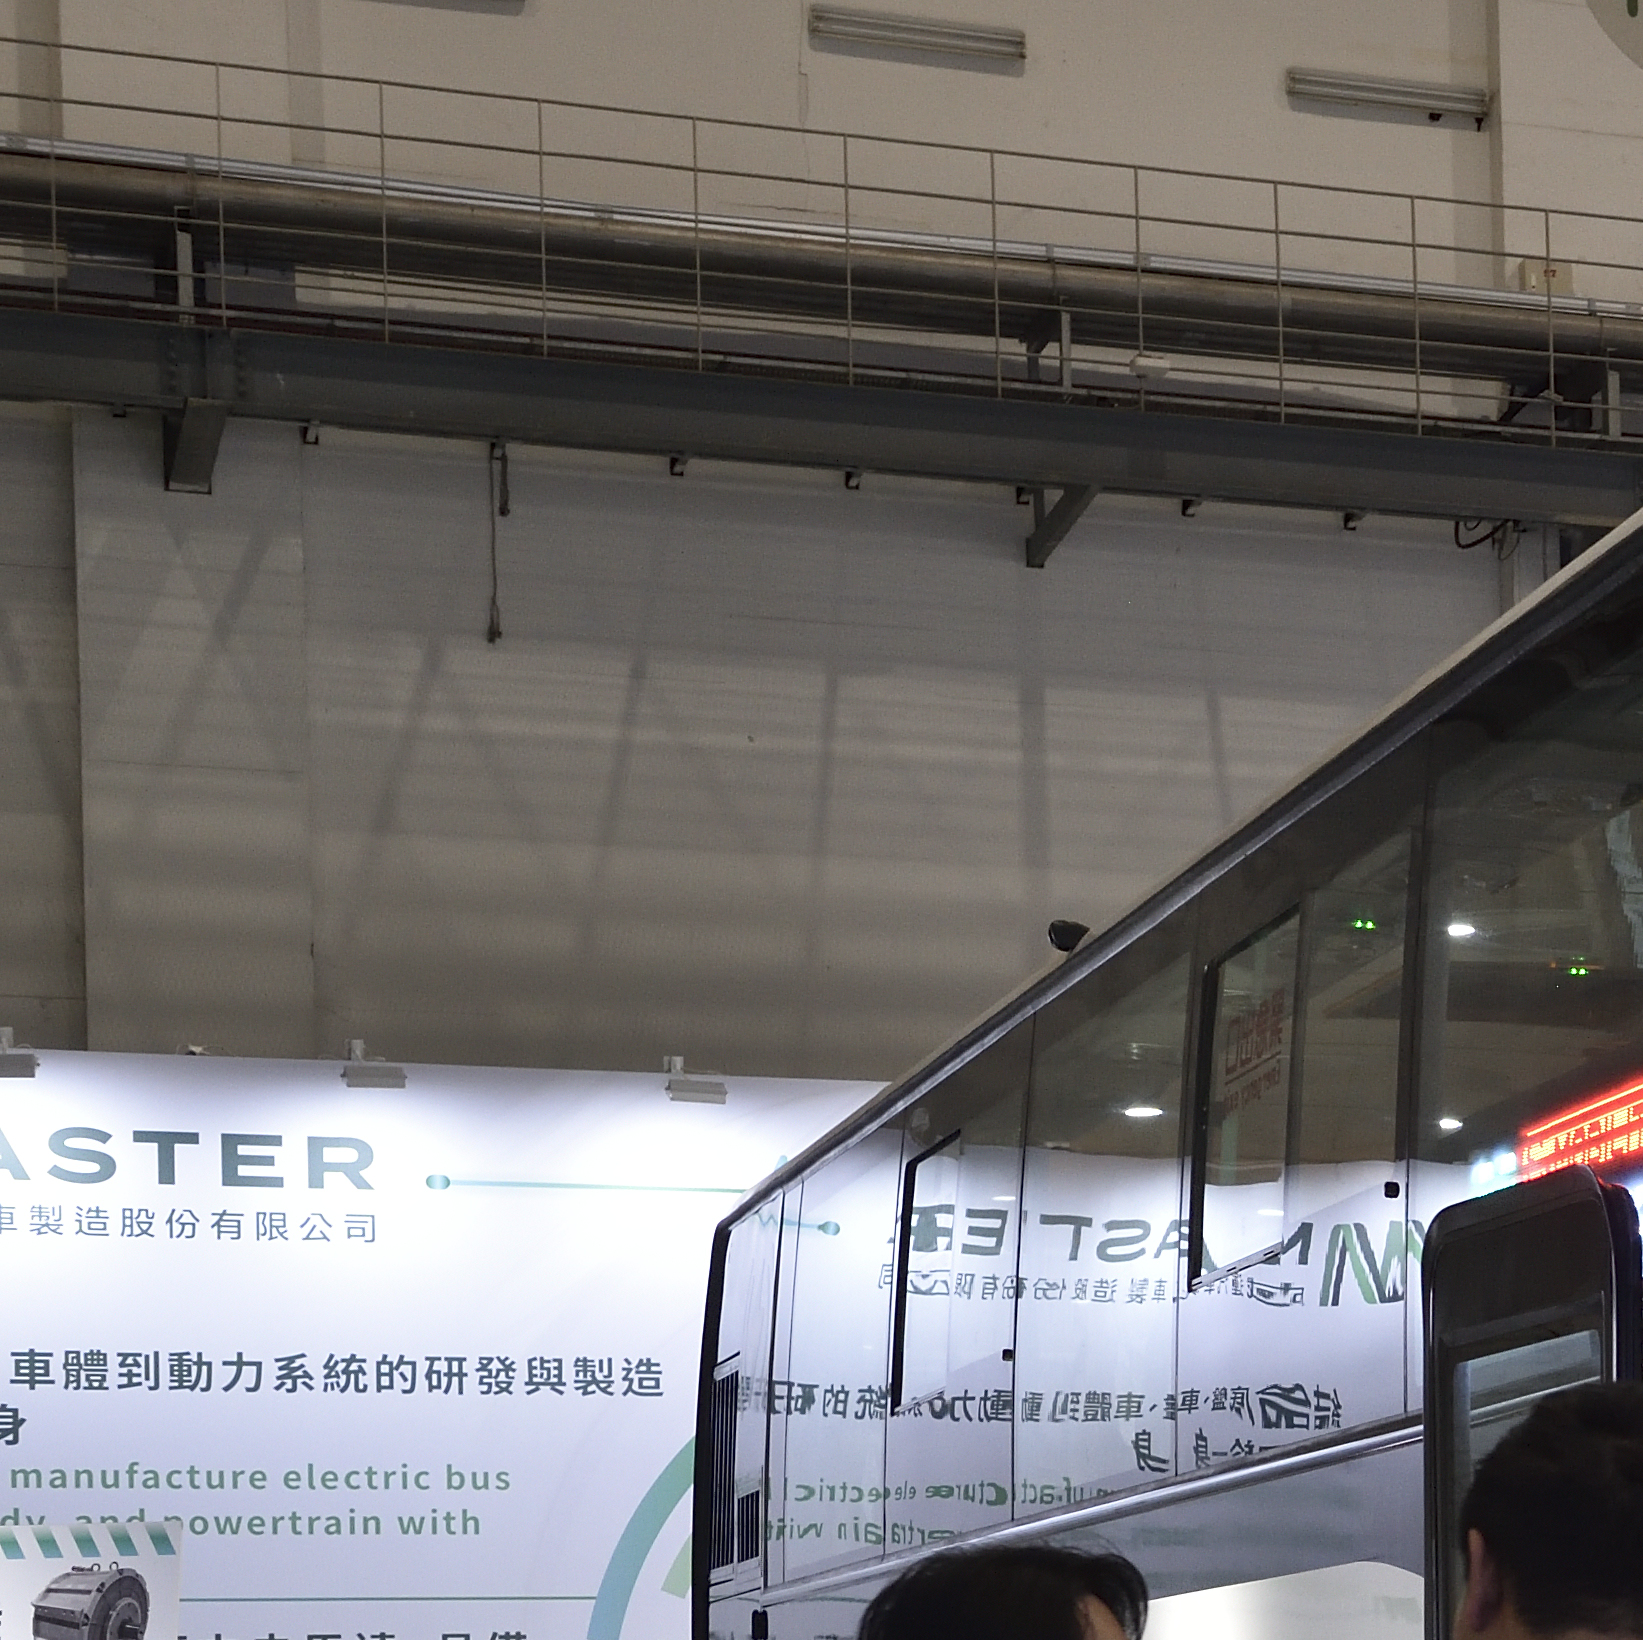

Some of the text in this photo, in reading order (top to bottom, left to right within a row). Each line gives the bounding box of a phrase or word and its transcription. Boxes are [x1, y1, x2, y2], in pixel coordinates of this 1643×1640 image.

[9, 1349, 664, 1398] 車體到動力系統的研發與製造
[9, 1461, 512, 1493] manufacture electric bus
[397, 1508, 482, 1537] with
